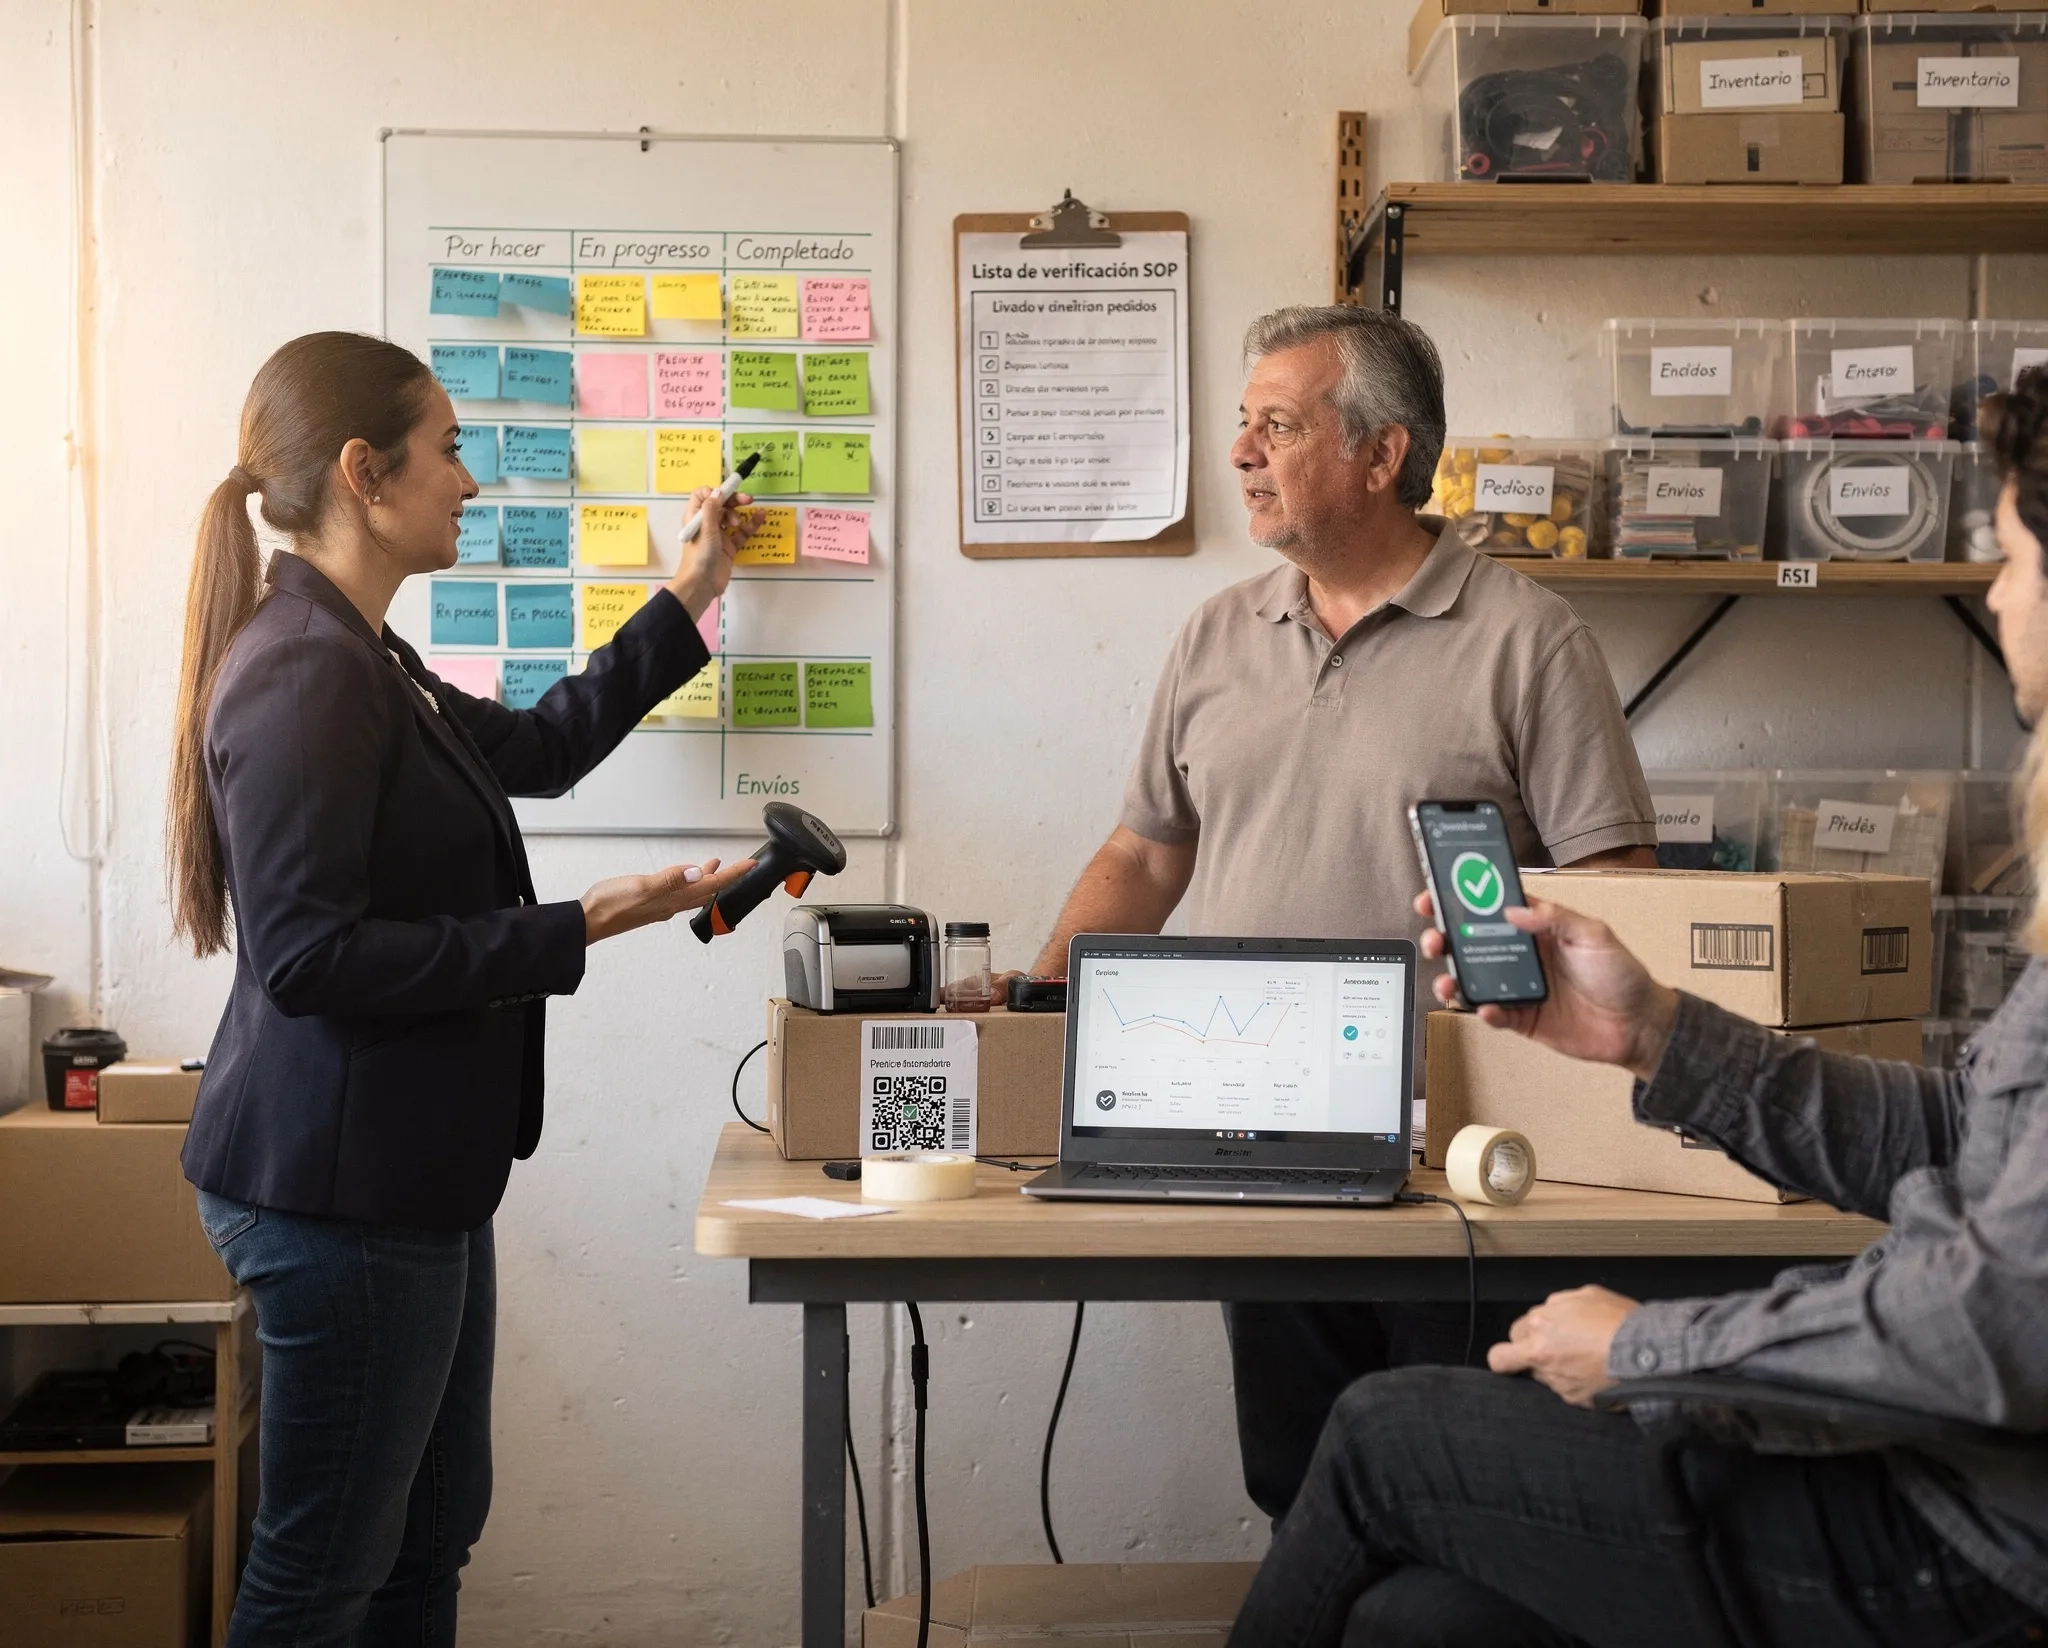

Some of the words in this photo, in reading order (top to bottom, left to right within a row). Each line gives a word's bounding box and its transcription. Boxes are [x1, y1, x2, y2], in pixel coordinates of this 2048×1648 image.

[1709, 71, 1792, 90] Inventario
[1924, 71, 2010, 88] Inventario
[445, 235, 483, 258] Por
[489, 236, 545, 258] hacer
[579, 237, 606, 258] En
[736, 238, 854, 268] Completado
[972, 264, 1012, 279] Lista
[1017, 263, 1037, 279] de
[1042, 262, 1139, 279] verificación
[1143, 263, 1178, 278] SOP
[736, 773, 800, 795] Envíos
